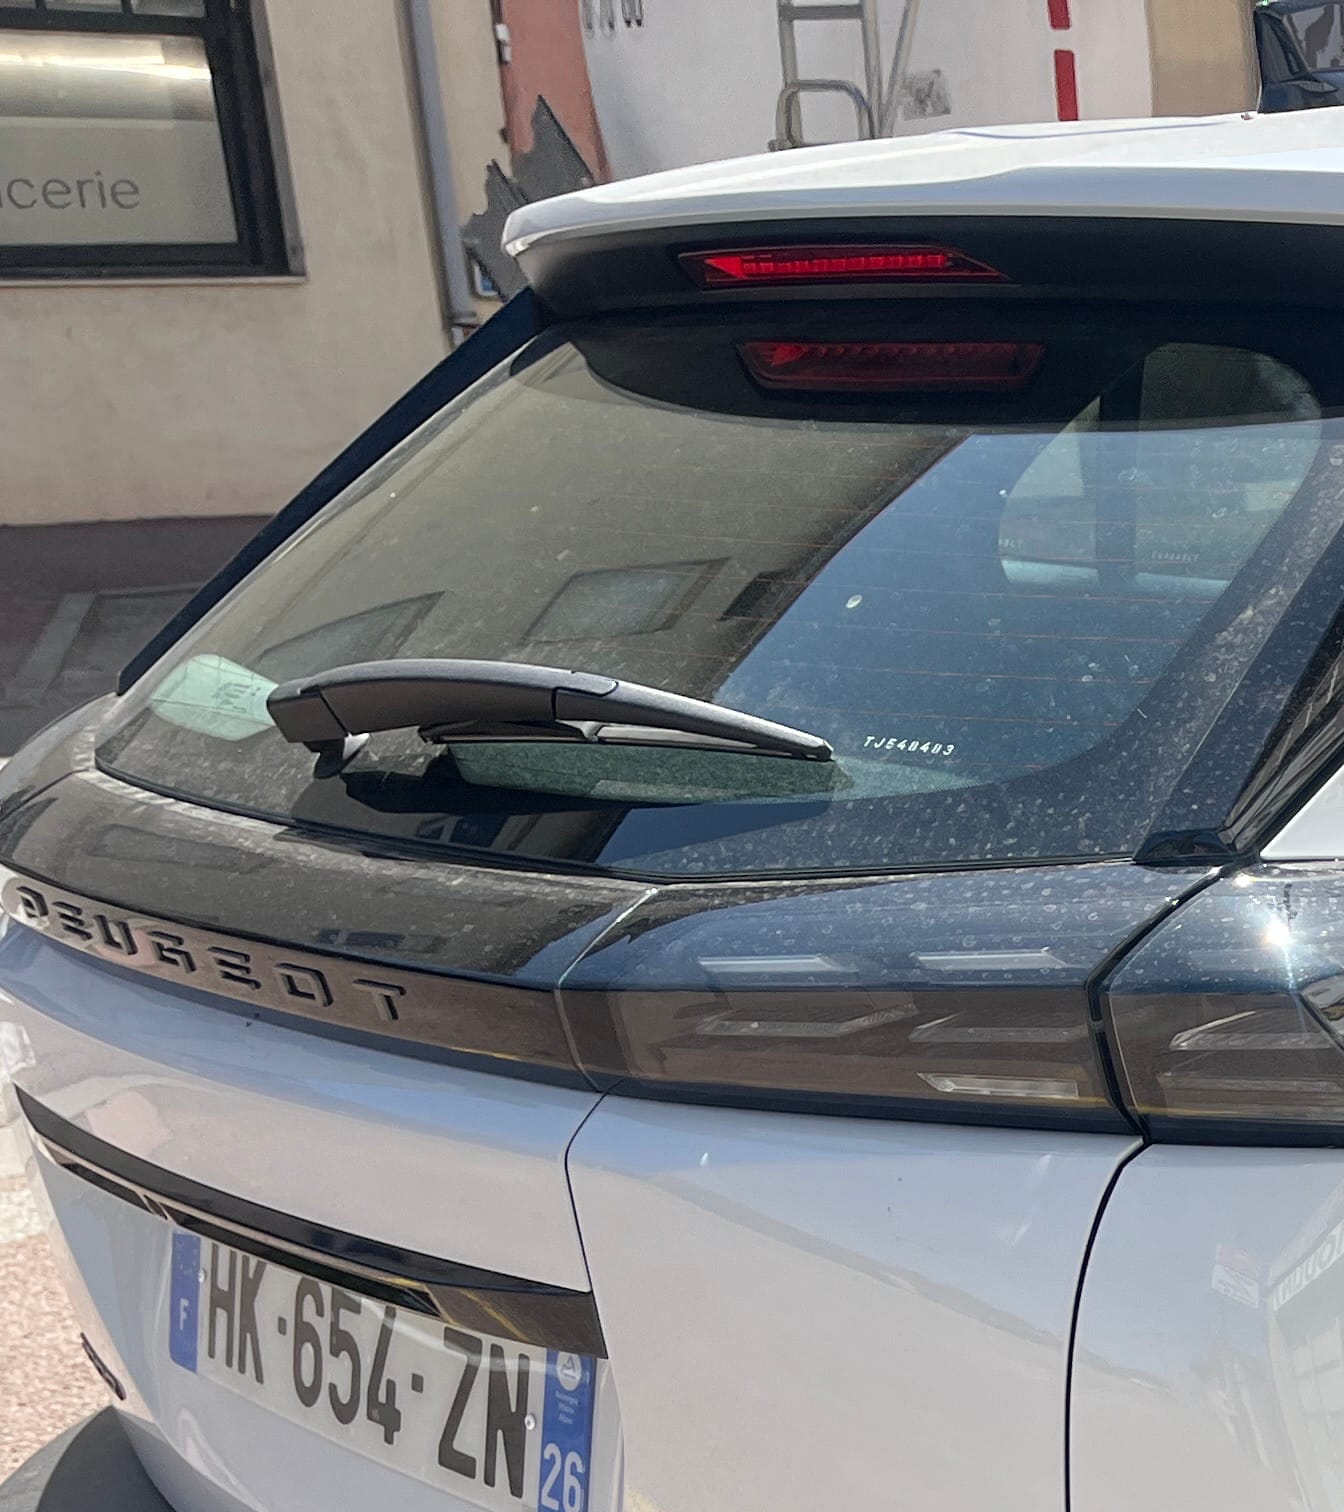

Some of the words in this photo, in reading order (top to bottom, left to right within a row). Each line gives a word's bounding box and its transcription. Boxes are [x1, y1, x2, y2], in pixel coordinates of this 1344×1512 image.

[0, 170, 140, 210] cerie
[863, 735, 955, 756] TJ540403
[15, 886, 407, 1022] PEUGEOT
[179, 1298, 190, 1331] F
